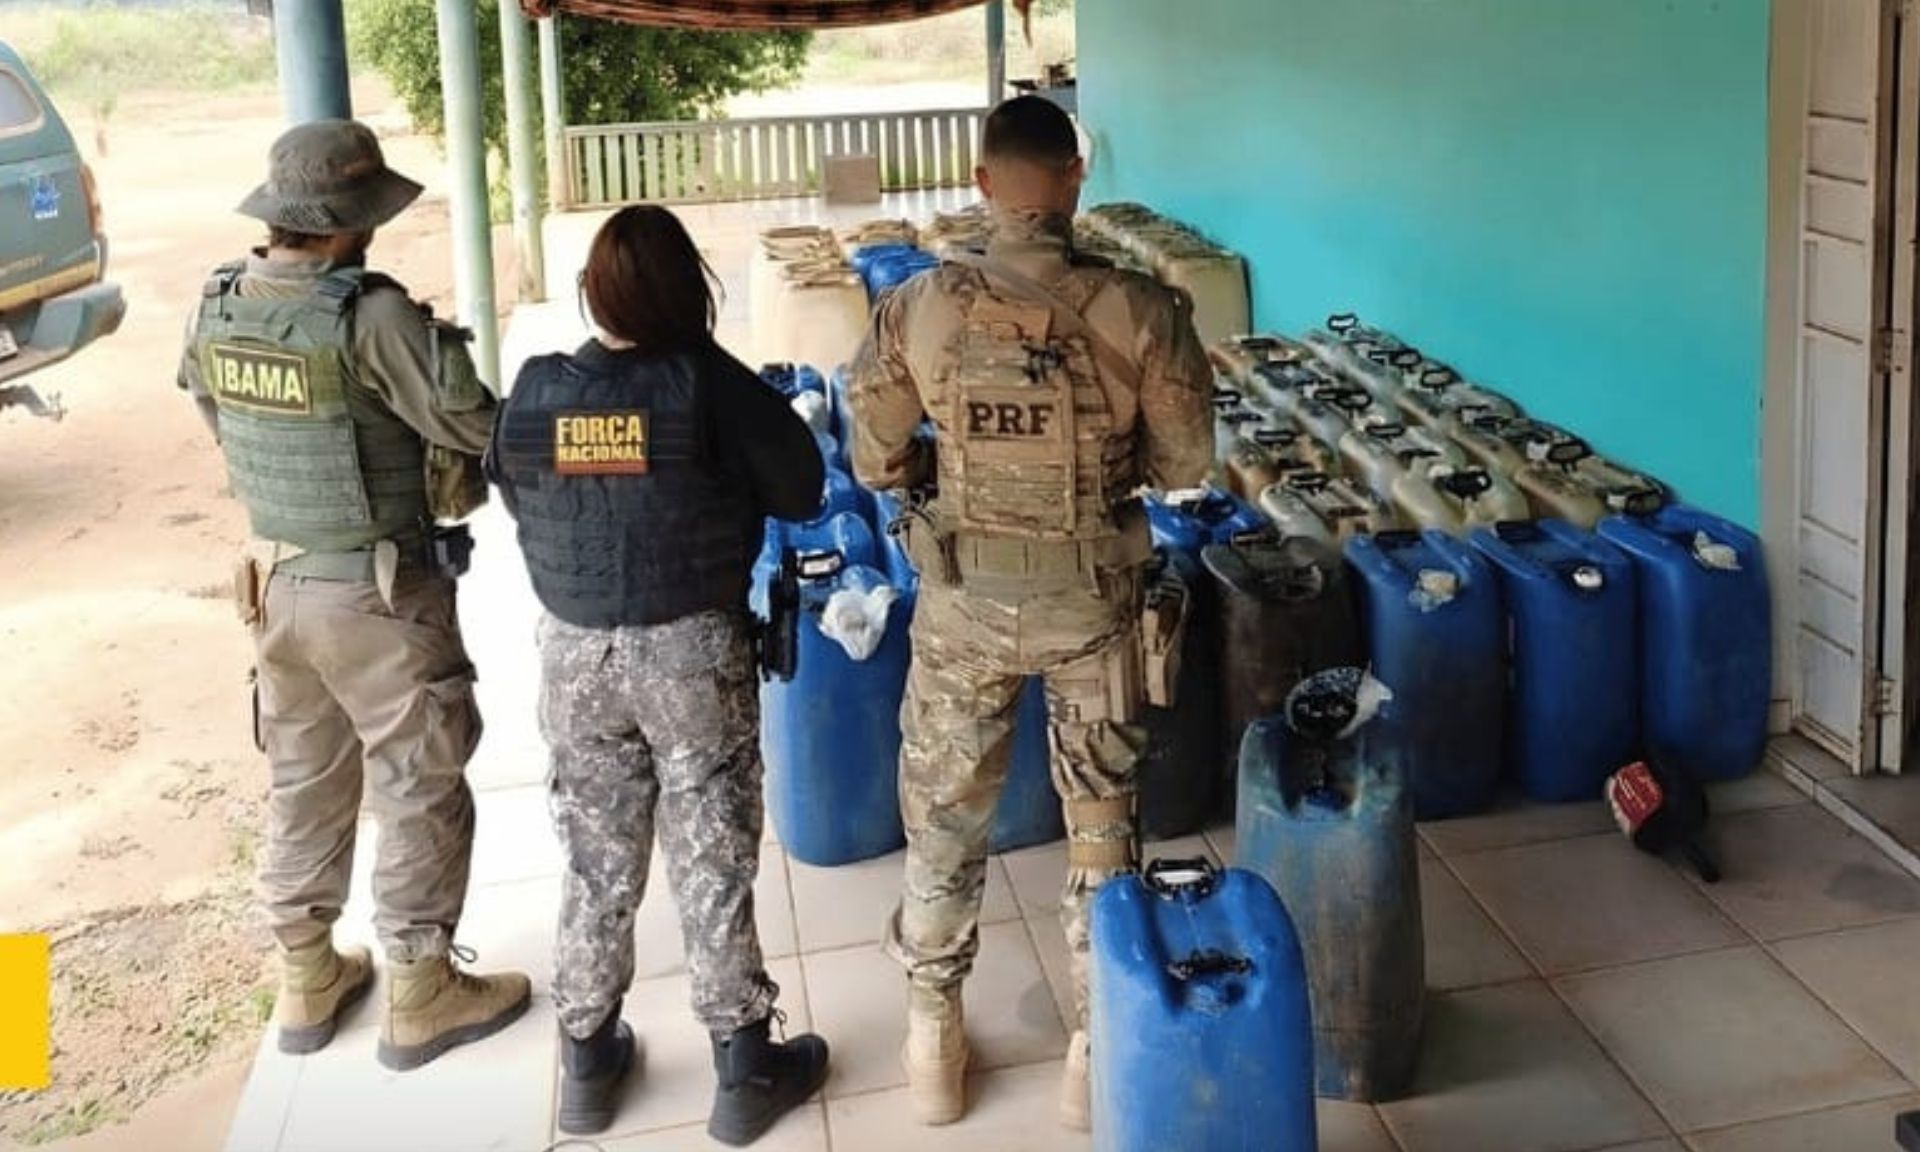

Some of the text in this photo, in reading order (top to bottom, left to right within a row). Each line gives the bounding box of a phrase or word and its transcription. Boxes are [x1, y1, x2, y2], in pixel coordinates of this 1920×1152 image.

[214, 357, 305, 403] IBAMA
[967, 401, 1054, 435] PRF
[557, 443, 644, 463] NACIONAL
